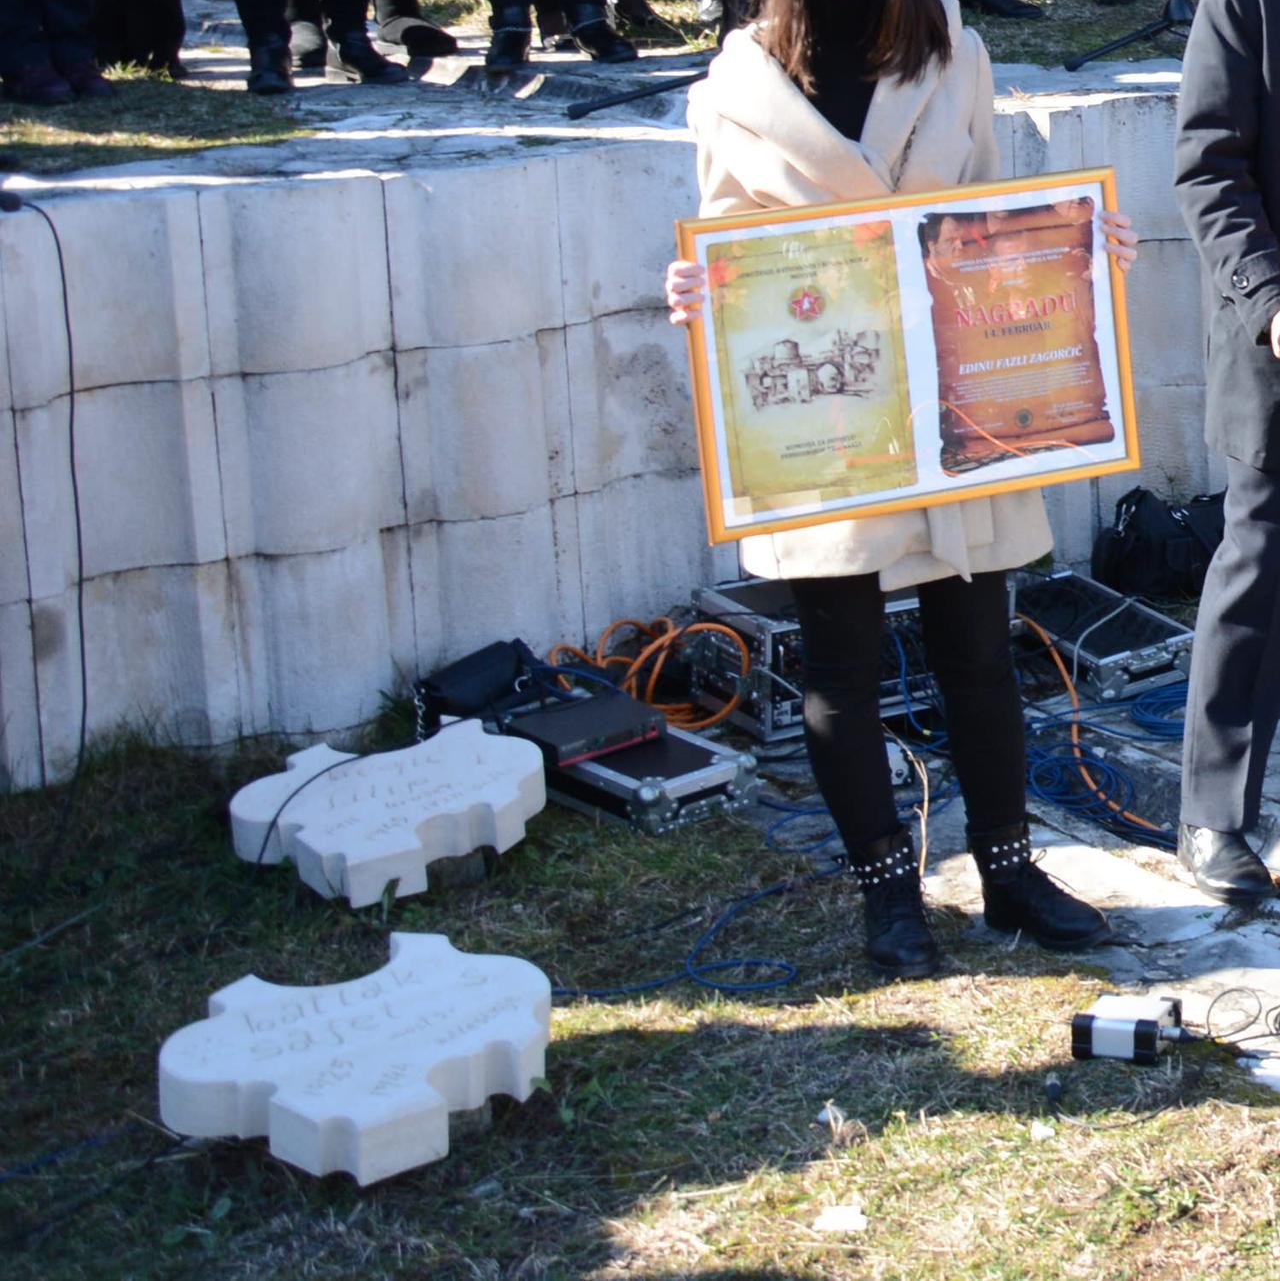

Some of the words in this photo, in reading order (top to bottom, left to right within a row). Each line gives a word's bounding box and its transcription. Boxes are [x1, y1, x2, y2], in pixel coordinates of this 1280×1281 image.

[953, 291, 1077, 328] NAGRADU
[1001, 321, 1051, 336] FEBRUAR
[959, 361, 994, 375] EDINU
[996, 355, 1027, 369] FAZLI
